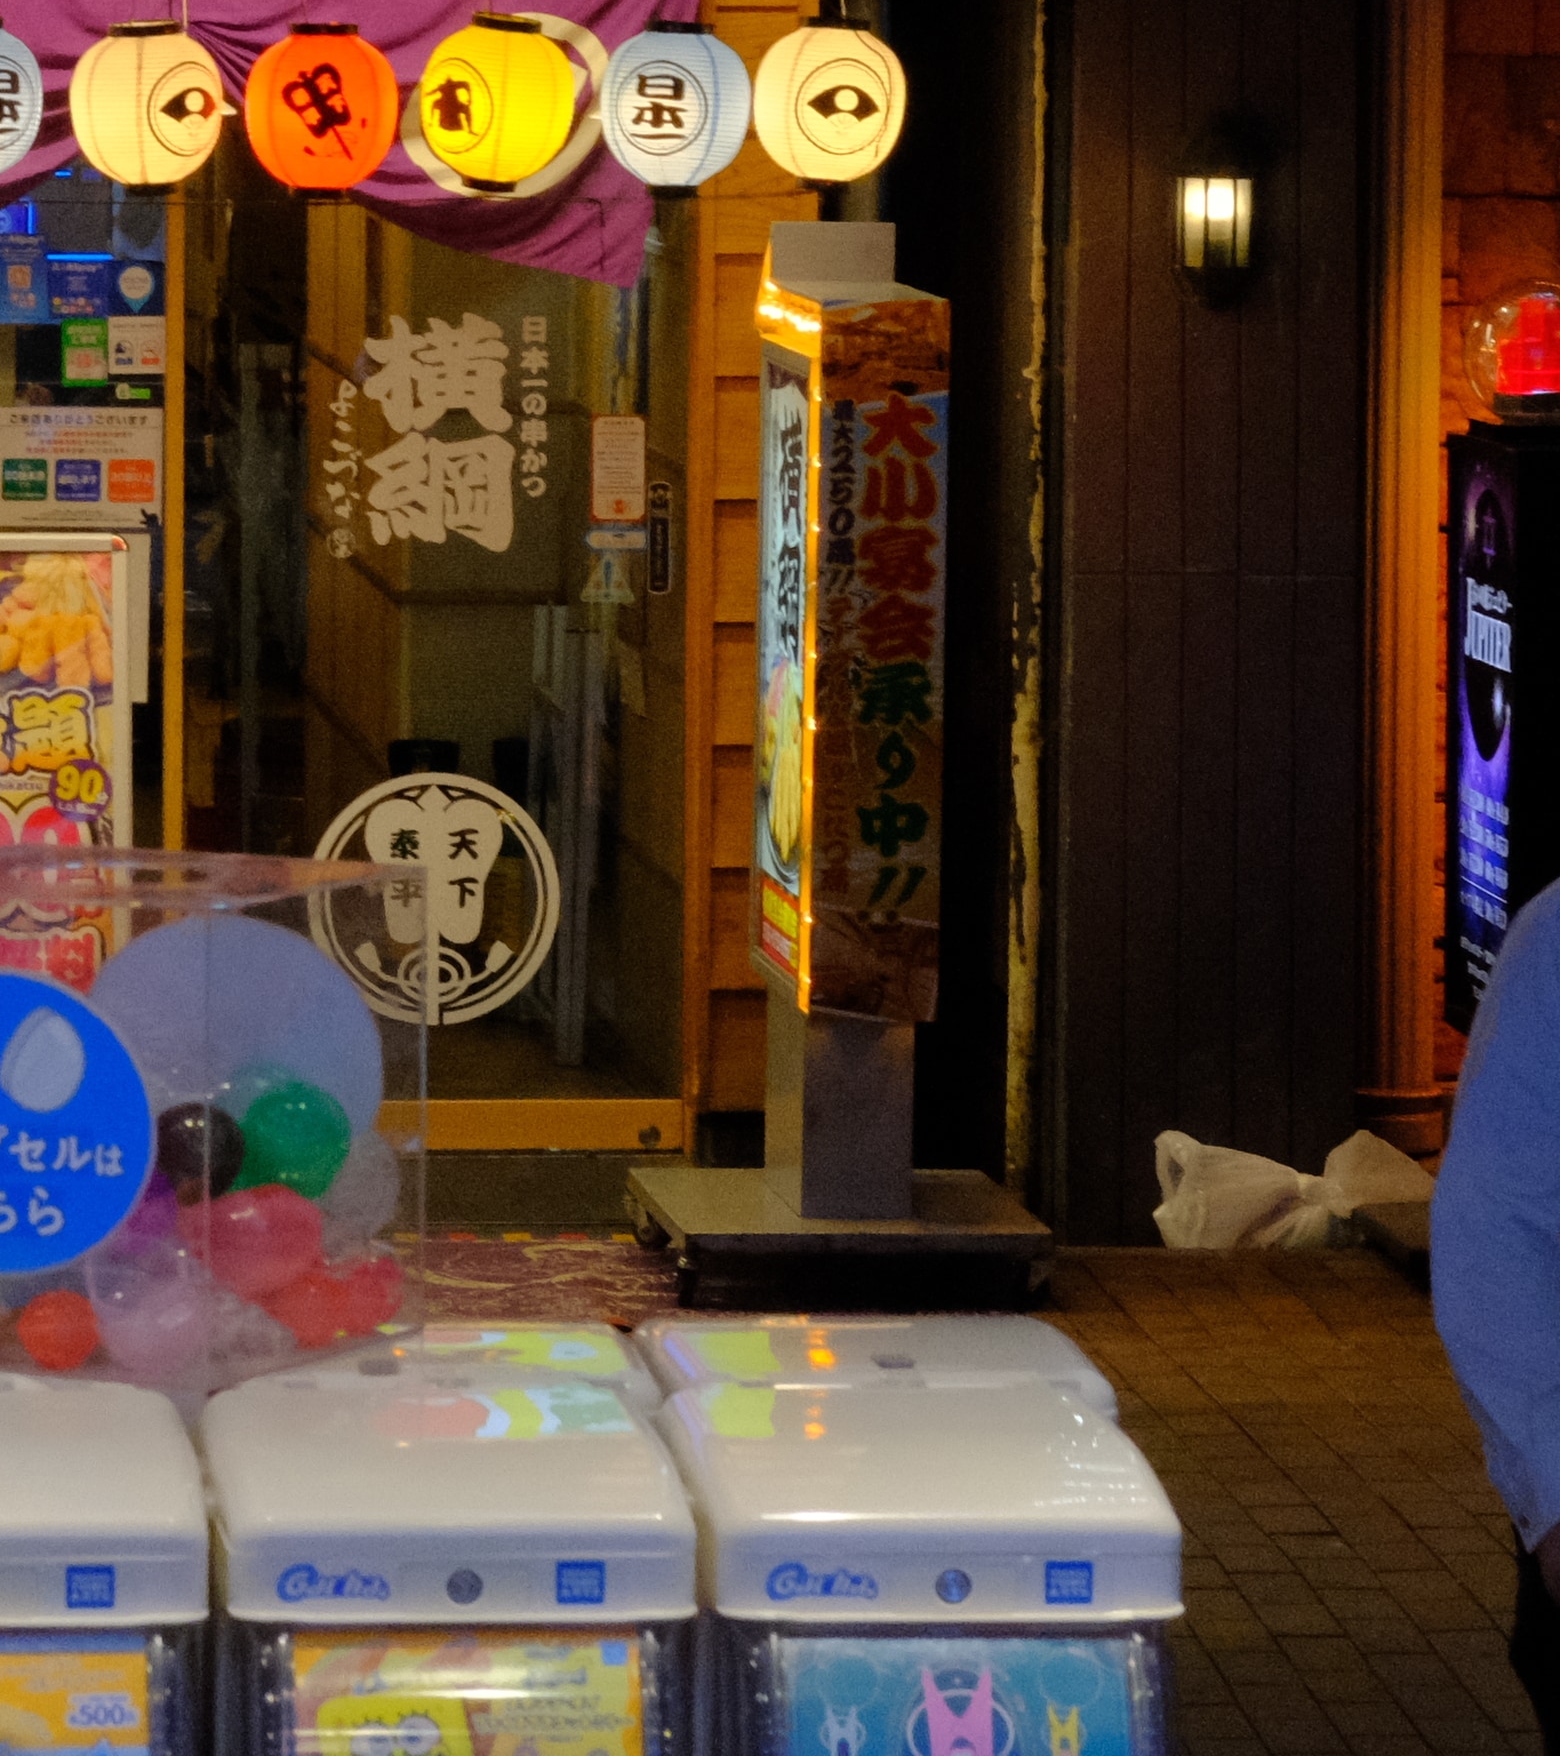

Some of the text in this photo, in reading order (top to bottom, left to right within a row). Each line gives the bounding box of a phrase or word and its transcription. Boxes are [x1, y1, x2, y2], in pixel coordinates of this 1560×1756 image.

[630, 73, 690, 140] 日本一
[363, 312, 515, 552] 横綱
[520, 316, 548, 498] 日本一の串かつ
[390, 828, 423, 908] 泰平
[448, 827, 479, 909] 天下
